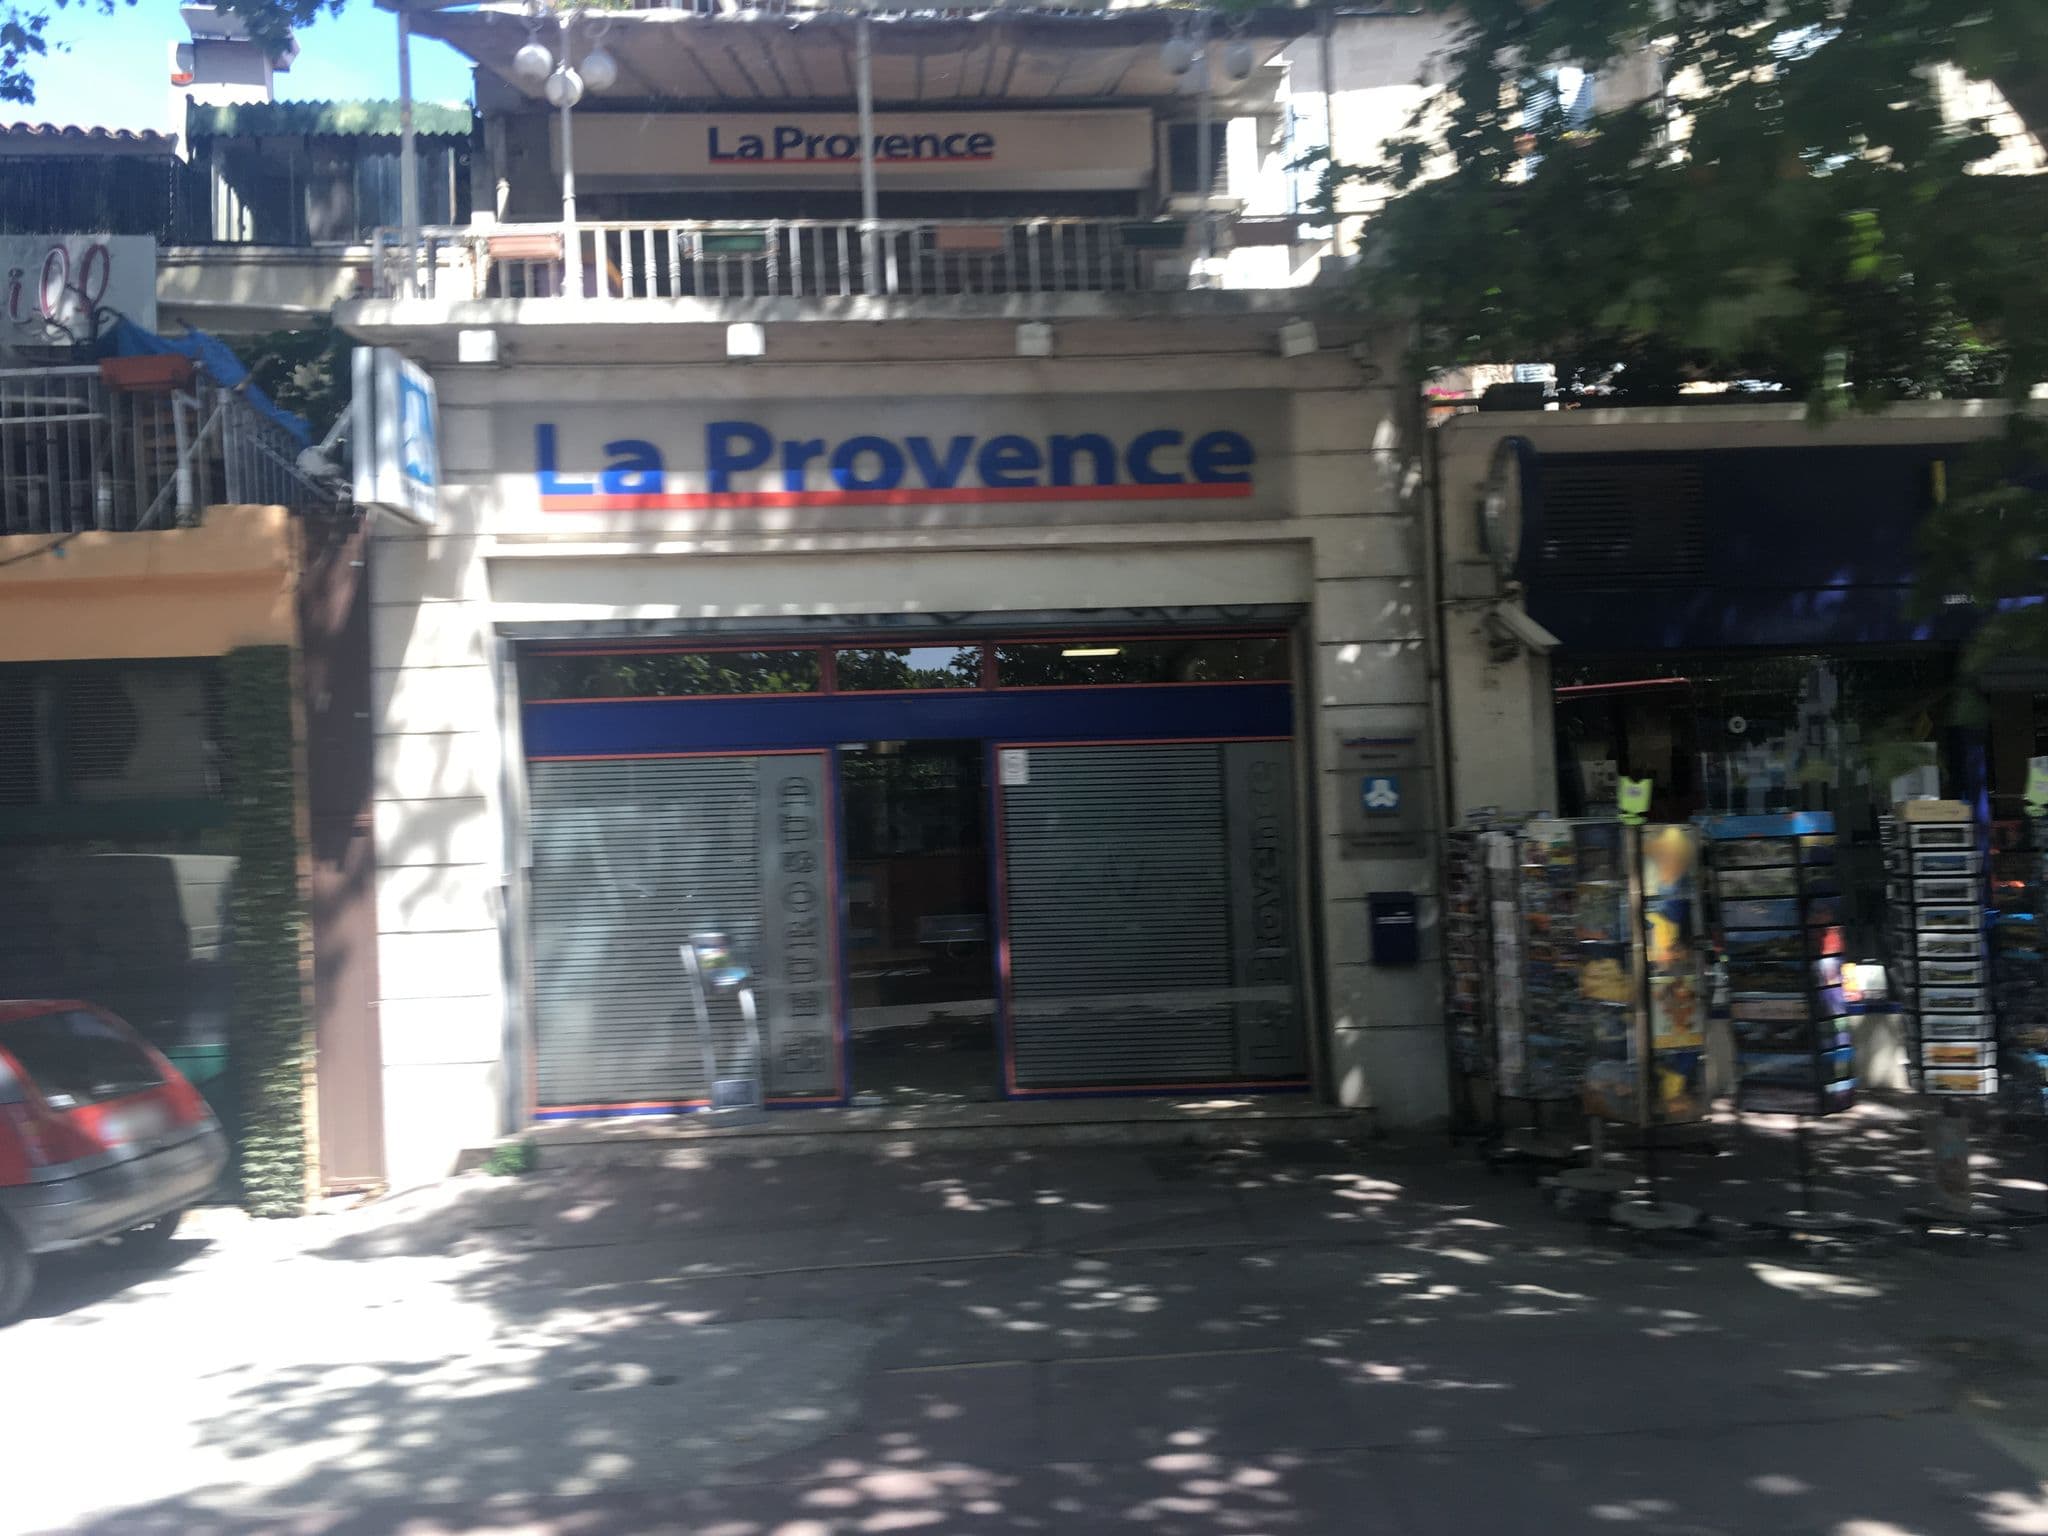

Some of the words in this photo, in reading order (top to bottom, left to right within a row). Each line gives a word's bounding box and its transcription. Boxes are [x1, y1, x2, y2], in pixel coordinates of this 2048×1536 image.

[537, 424, 664, 497] La
[706, 421, 1255, 494] Provence
[777, 776, 821, 1017] EUROSUD
